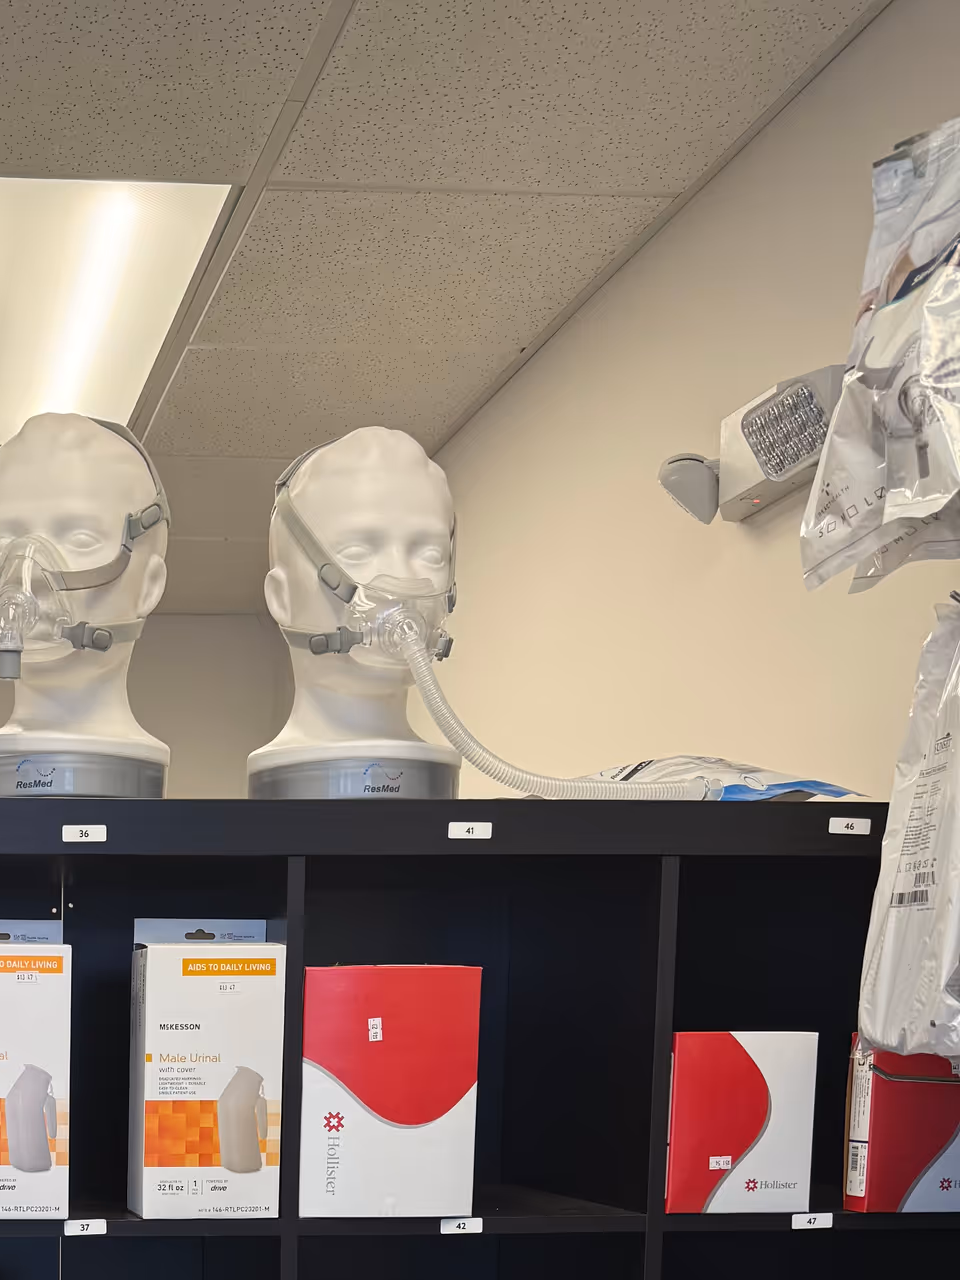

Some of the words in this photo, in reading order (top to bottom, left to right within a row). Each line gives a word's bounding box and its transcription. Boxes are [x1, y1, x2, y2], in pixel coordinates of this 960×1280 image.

[16, 780, 53, 789] ResMed
[363, 782, 400, 794] ResMed
[844, 822, 855, 831] 46
[79, 829, 89, 838] 36
[6, 960, 29, 968] DAILY
[31, 960, 57, 968] LIVING
[159, 1053, 187, 1063] Male
[189, 1053, 221, 1063] Urinal
[326, 1137, 340, 1196] Hollister
[760, 1180, 798, 1189] Hollister
[807, 1217, 817, 1225] 47
[456, 1222, 466, 1230] 42
